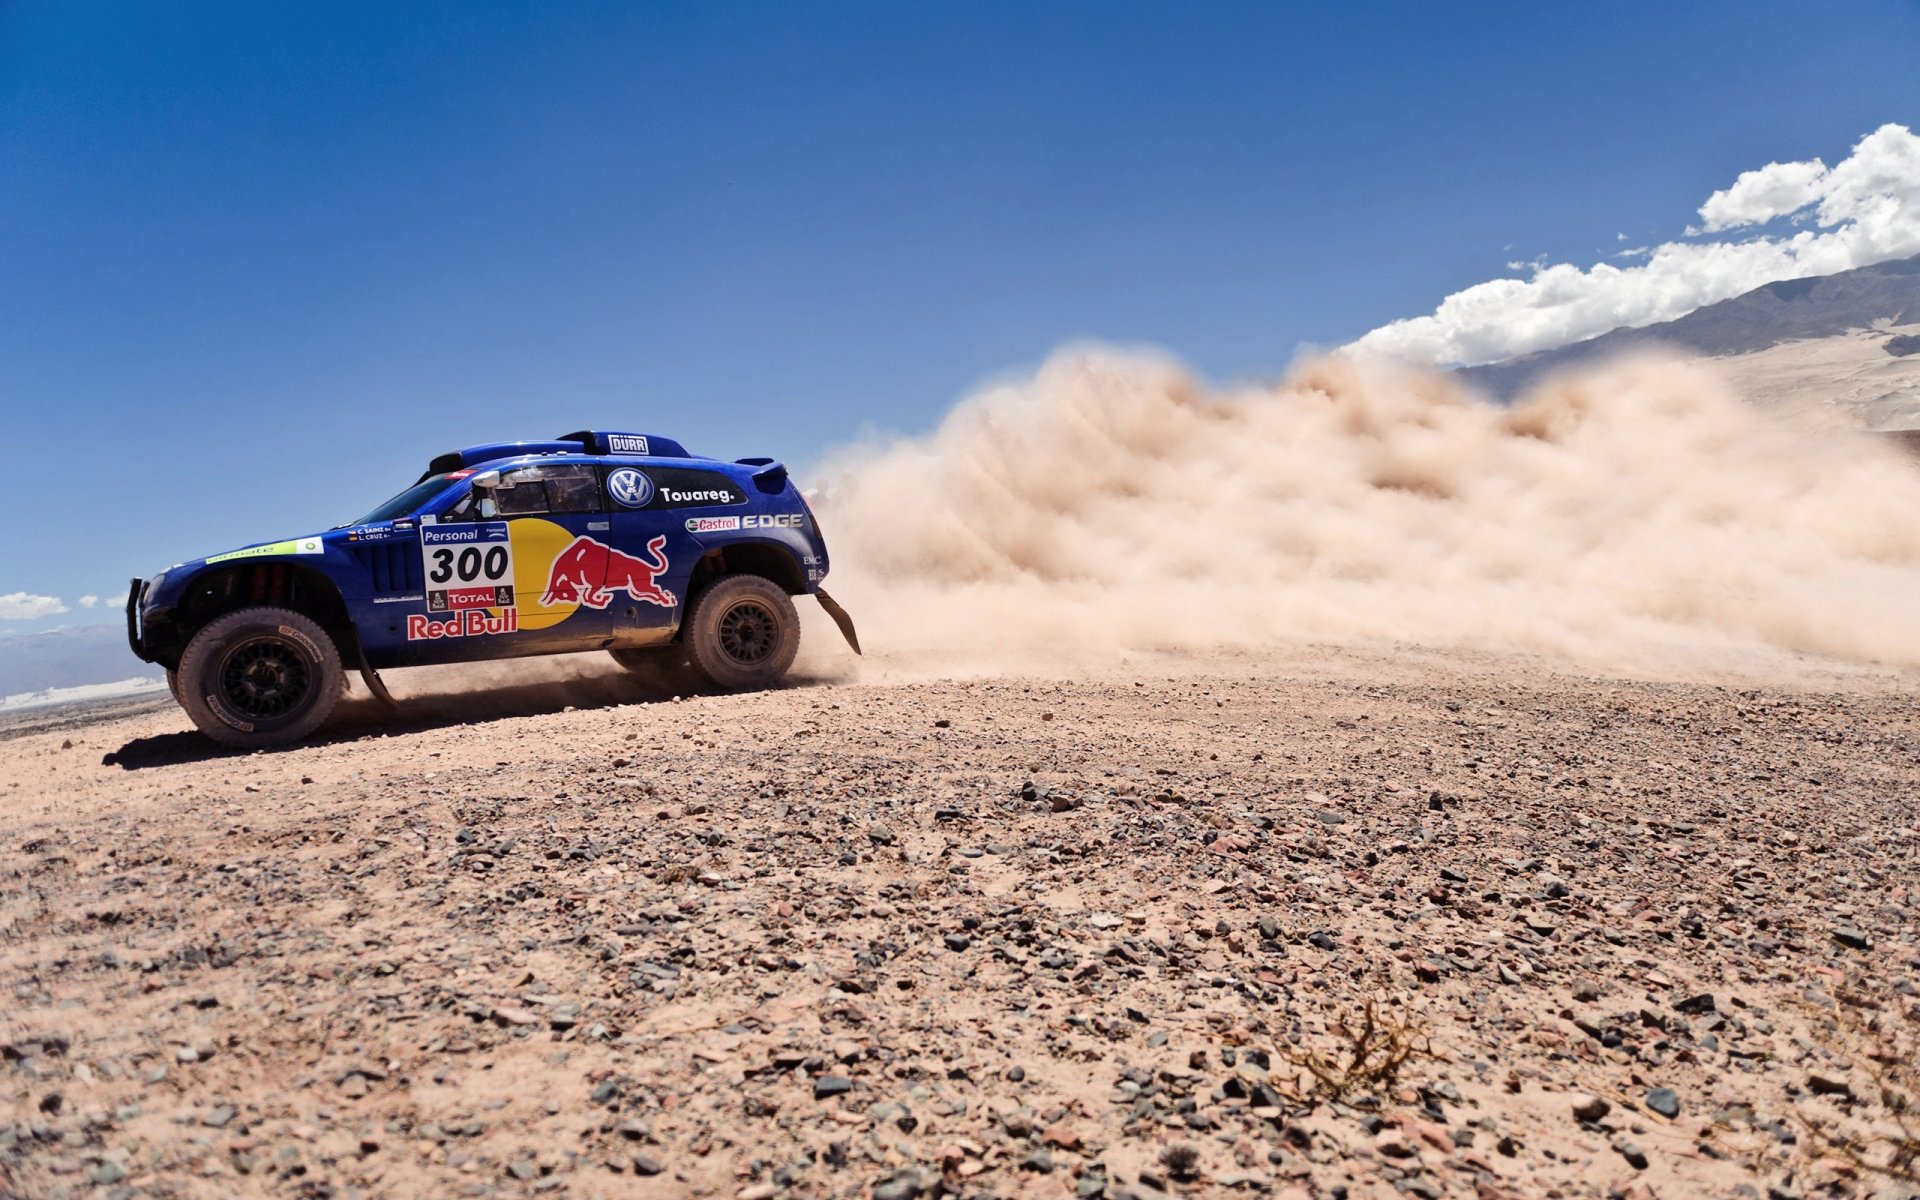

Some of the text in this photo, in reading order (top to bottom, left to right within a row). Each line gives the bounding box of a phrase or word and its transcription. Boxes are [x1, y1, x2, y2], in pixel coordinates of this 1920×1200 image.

[612, 435, 645, 451] DÜRR
[660, 487, 735, 503] Touareg.
[699, 514, 804, 531] Castrol EDGE
[425, 529, 478, 542] Personal
[430, 545, 509, 583] 300
[449, 594, 495, 604] TOTAL
[407, 607, 518, 641] Red Bull
